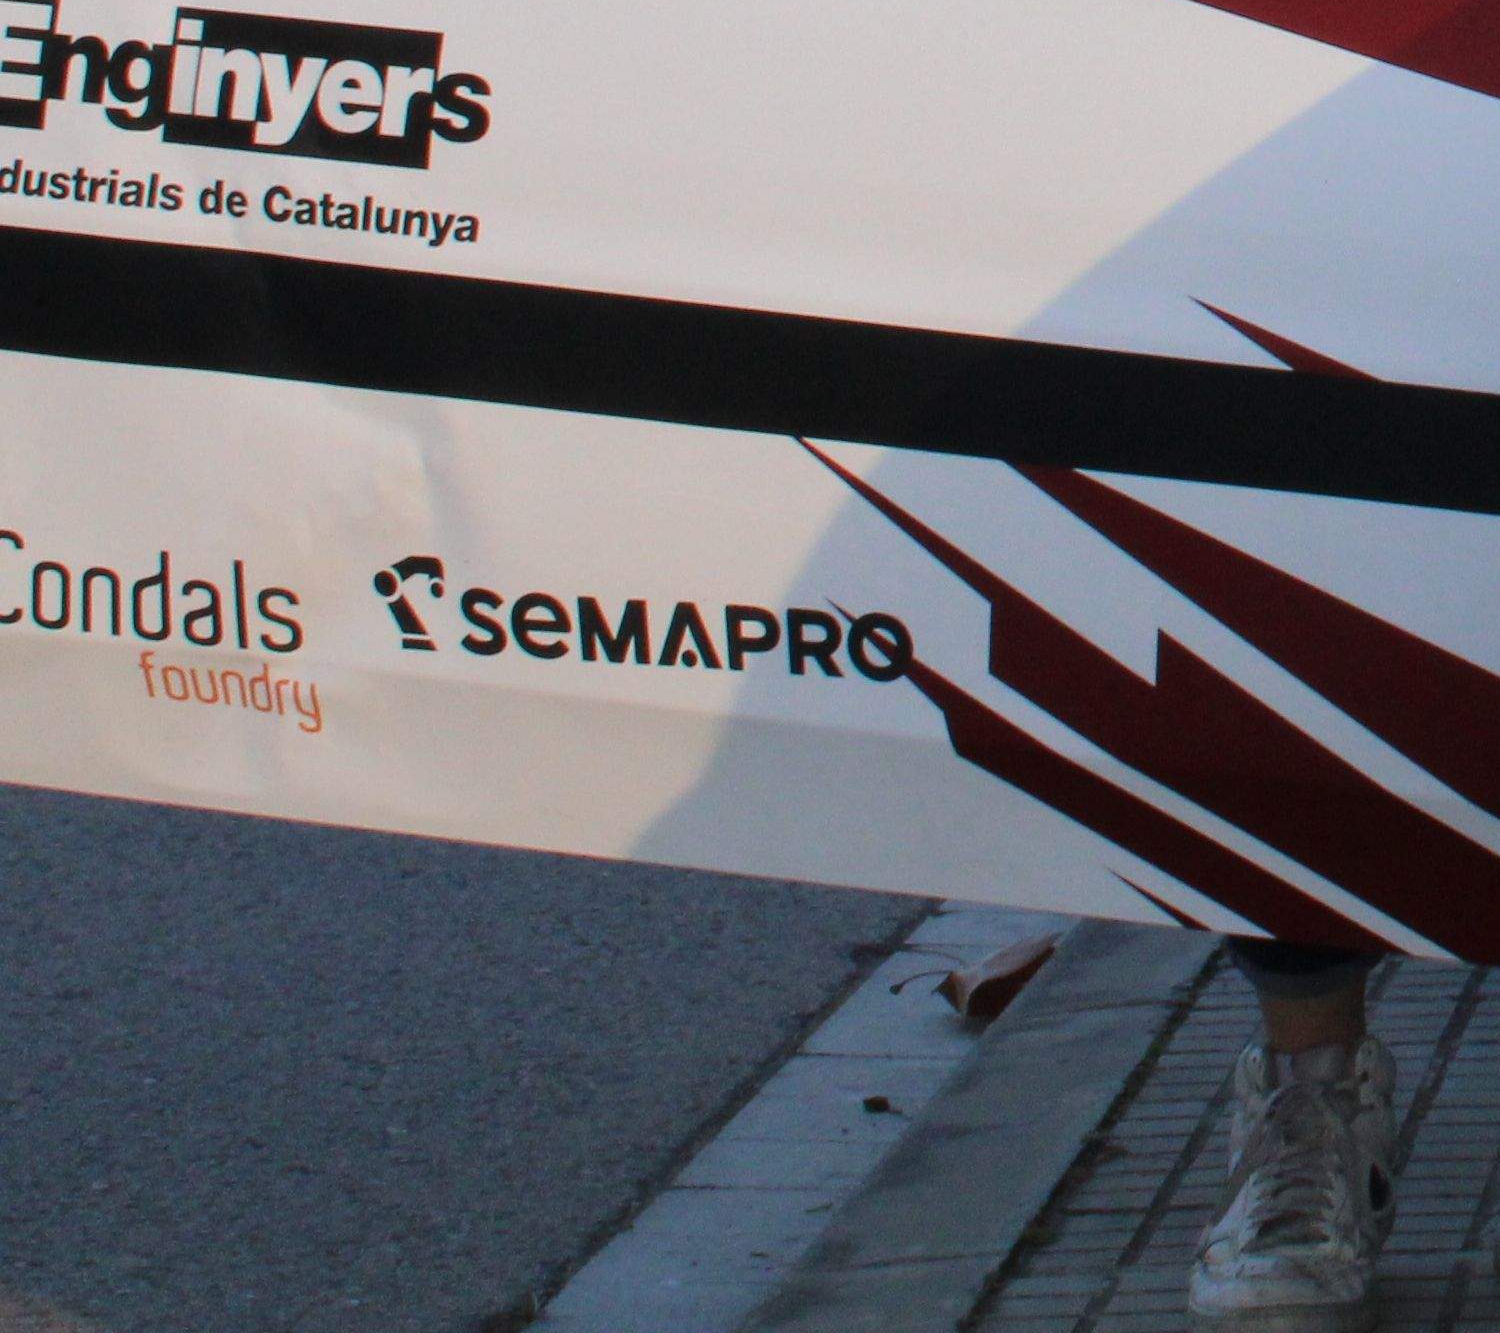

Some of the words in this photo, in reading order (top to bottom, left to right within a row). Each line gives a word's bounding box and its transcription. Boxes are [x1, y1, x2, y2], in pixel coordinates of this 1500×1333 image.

[199, 180, 249, 217] de
[264, 185, 480, 248] Catalunya
[138, 650, 323, 734] foundry
